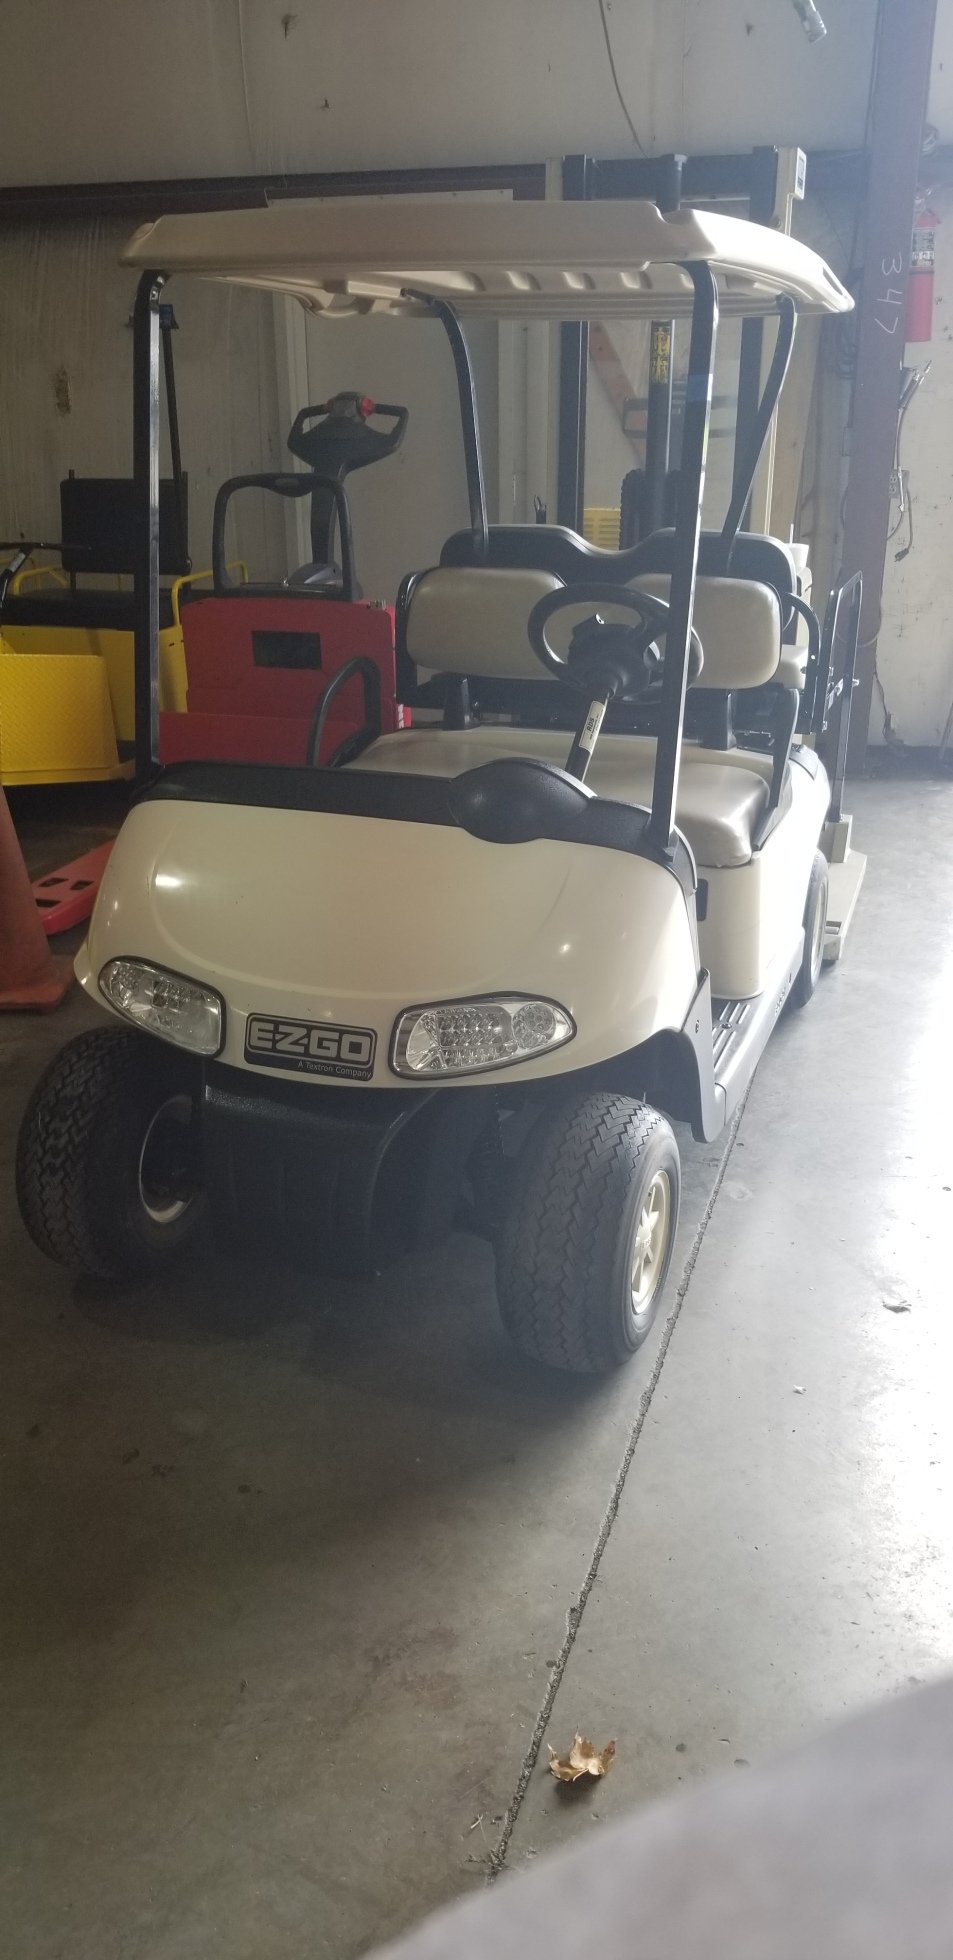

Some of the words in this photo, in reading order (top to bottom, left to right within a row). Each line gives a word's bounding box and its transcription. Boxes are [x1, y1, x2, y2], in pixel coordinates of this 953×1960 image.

[874, 251, 903, 334] 347
[298, 1060, 304, 1068] A
[306, 1061, 333, 1073] Textron
[335, 1066, 372, 1078] Company
